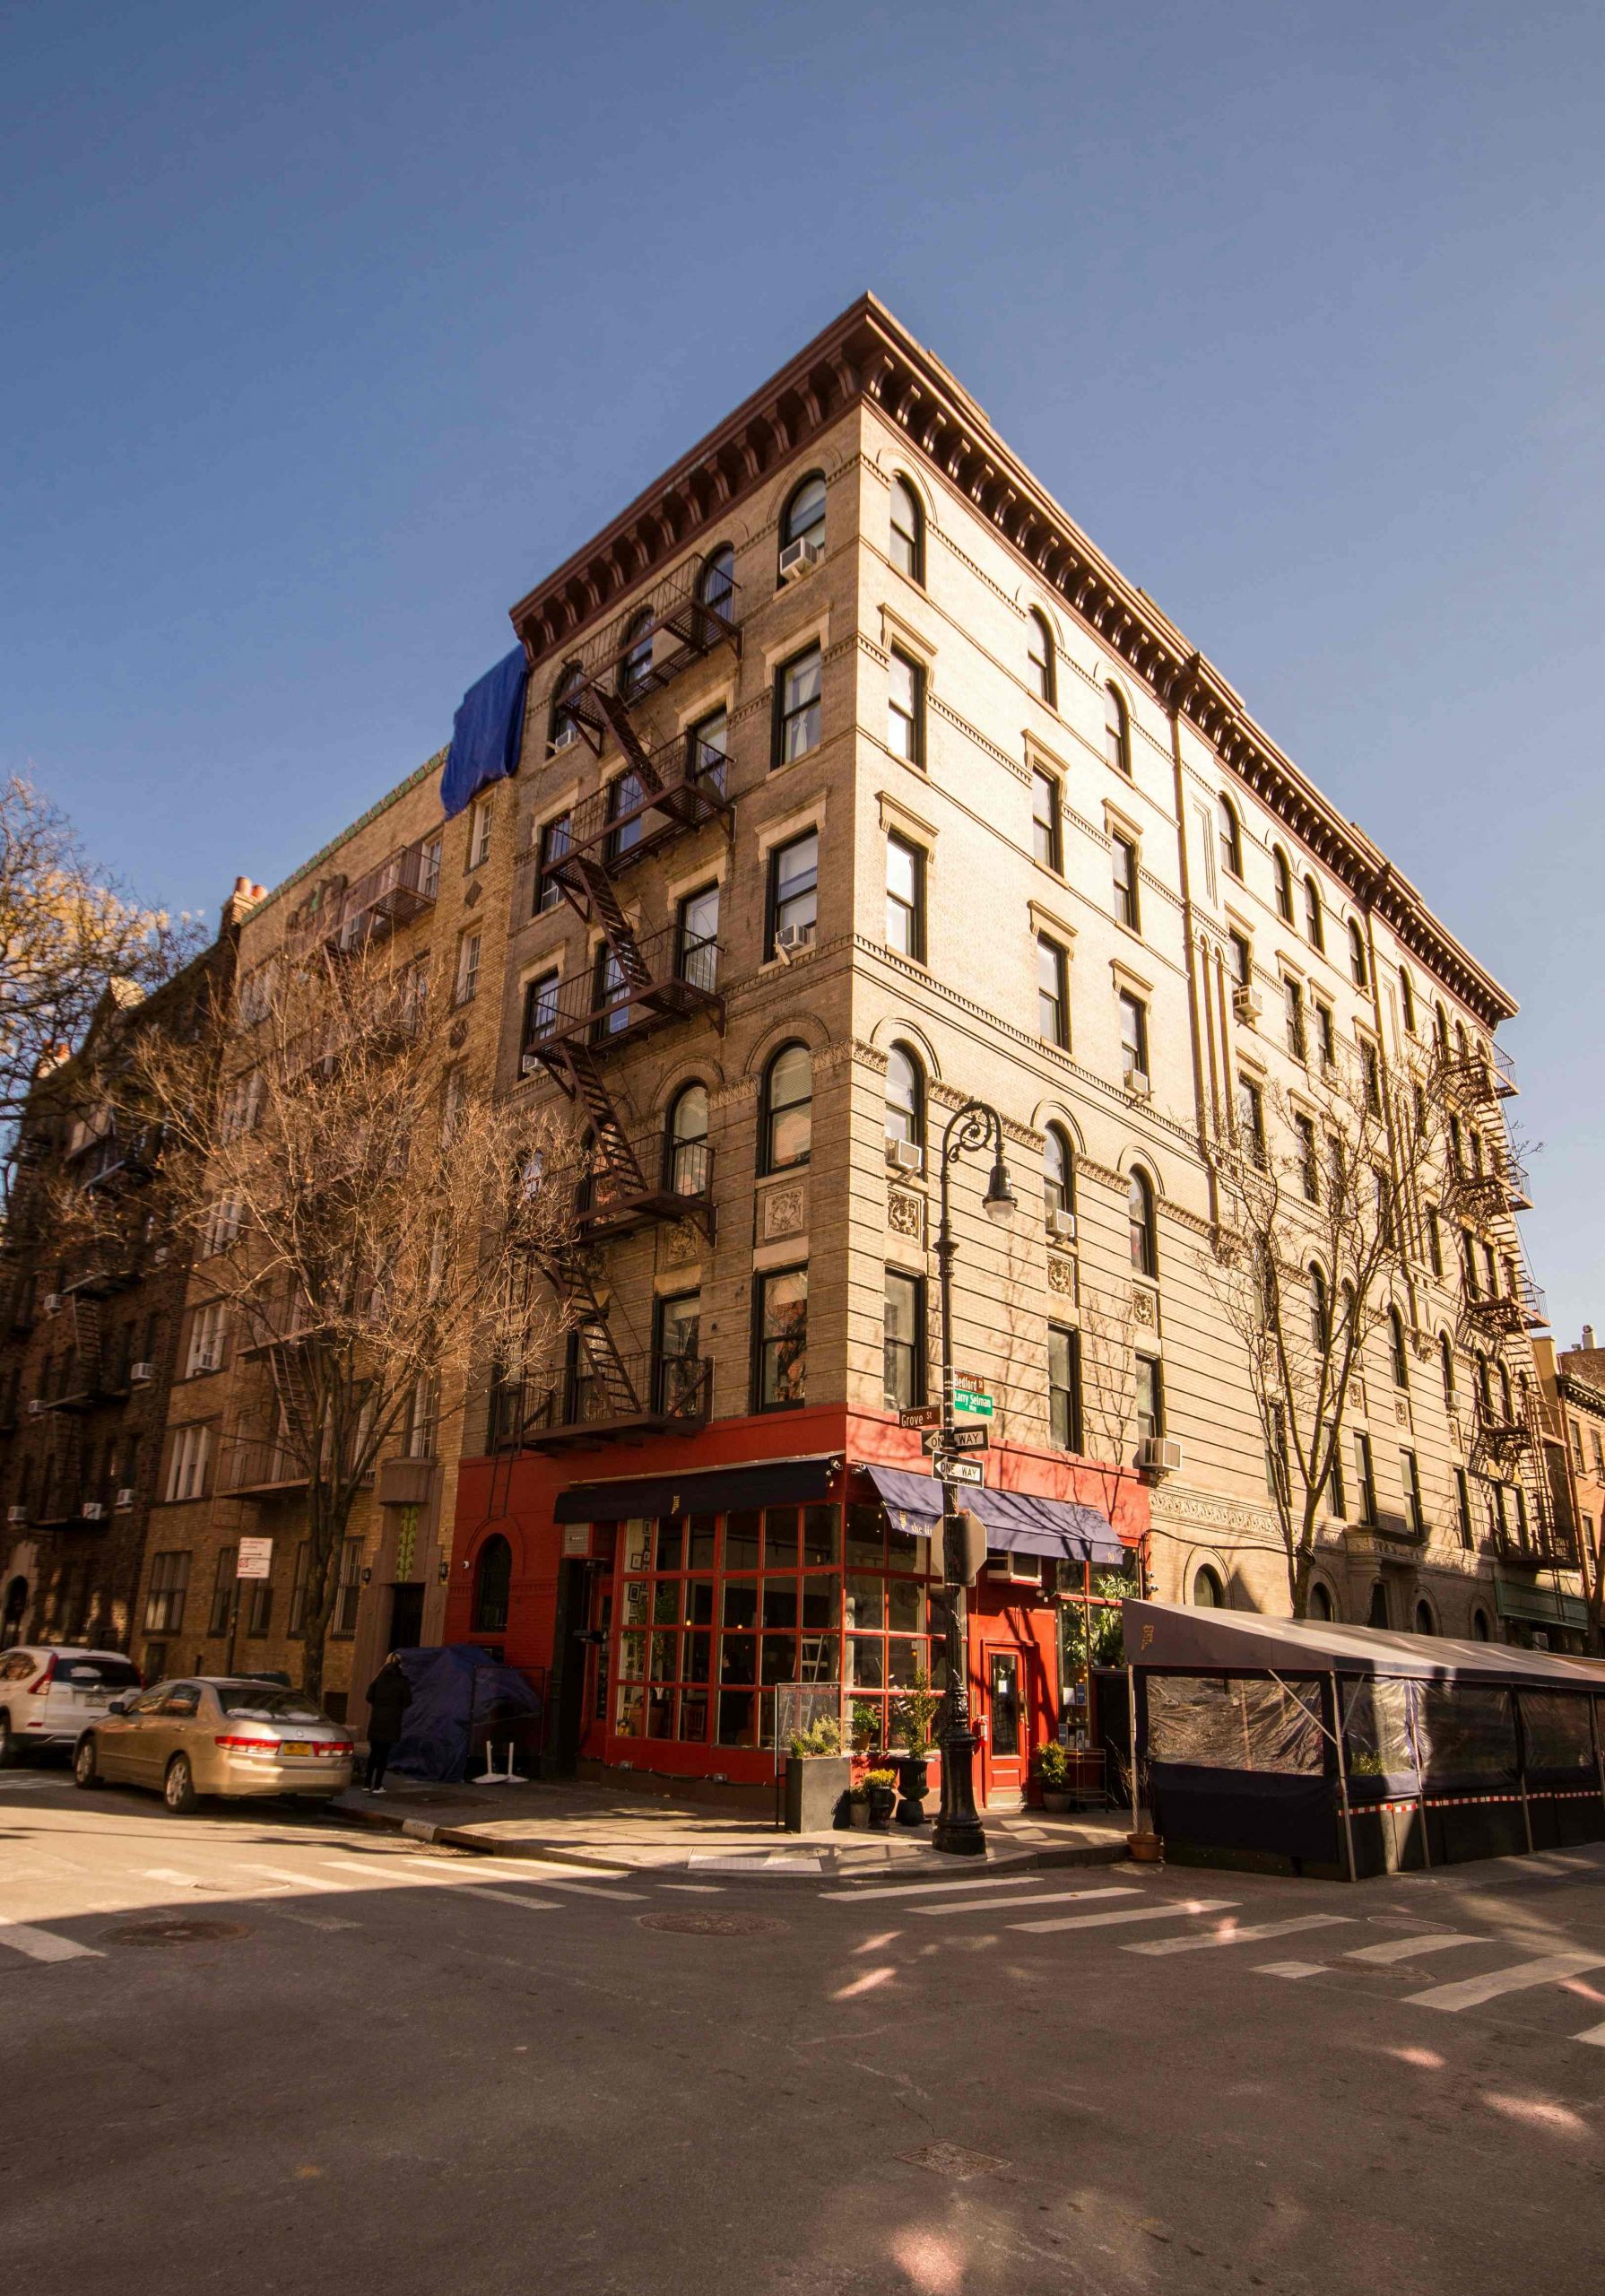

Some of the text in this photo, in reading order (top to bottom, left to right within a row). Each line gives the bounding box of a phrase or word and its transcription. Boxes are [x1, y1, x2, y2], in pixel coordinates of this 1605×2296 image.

[953, 1373, 977, 1391] Bedford
[954, 1390, 992, 1408] Larry Selman
[901, 1411, 933, 1427] Grove St
[931, 1432, 979, 1448] ON WAY
[941, 1462, 977, 1479] ONE WAY
[911, 1522, 923, 1534] the
